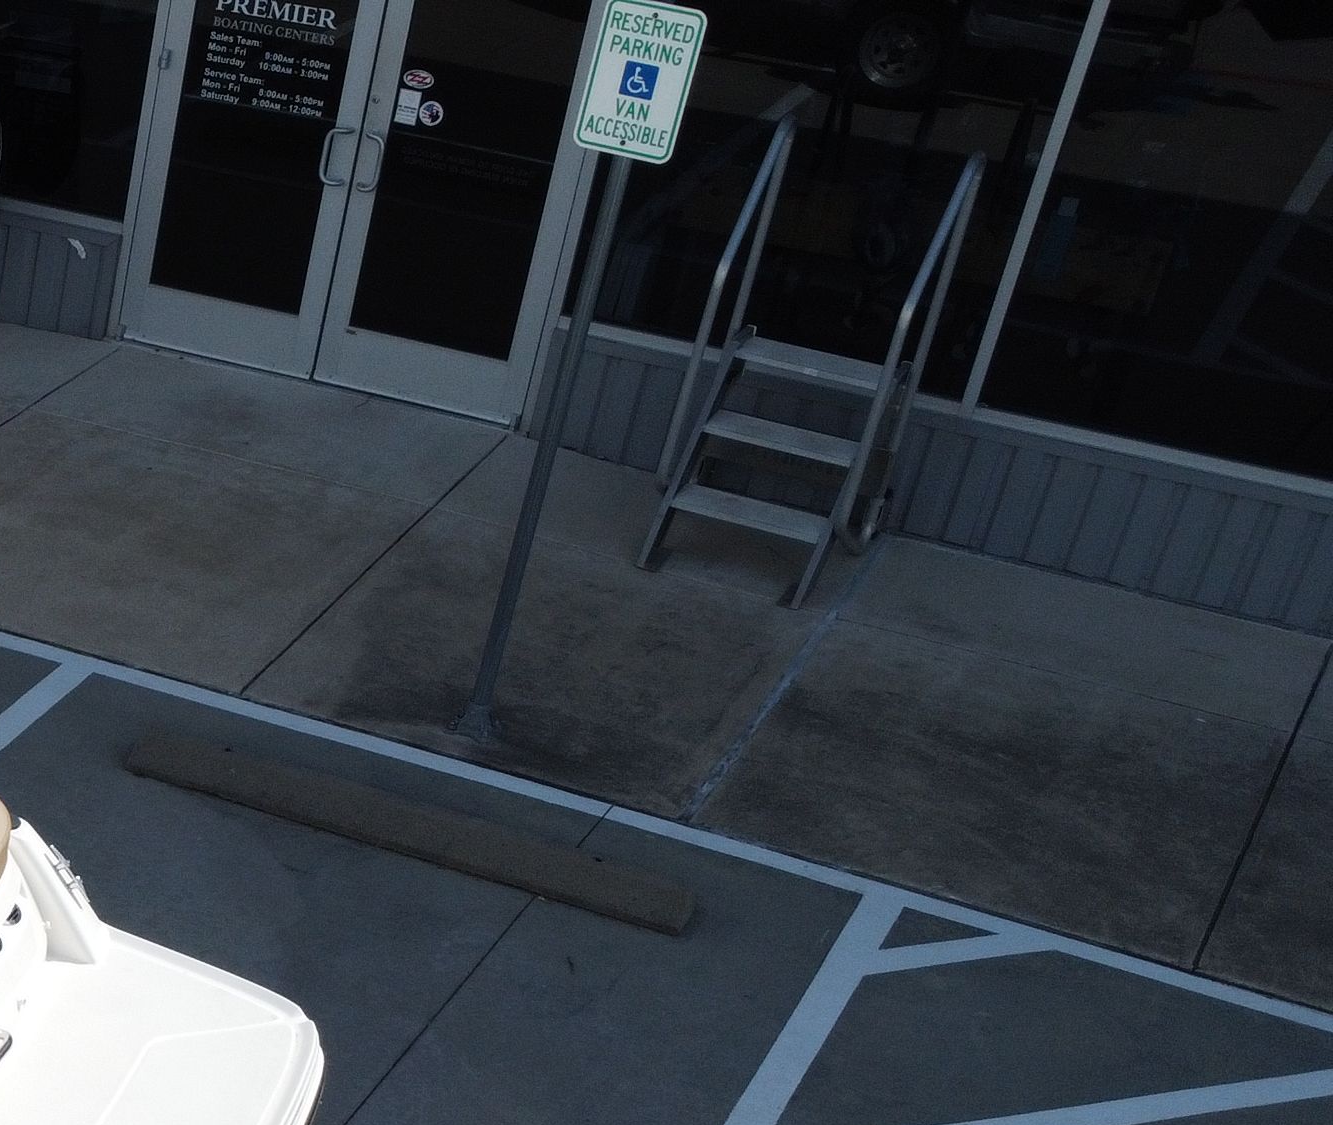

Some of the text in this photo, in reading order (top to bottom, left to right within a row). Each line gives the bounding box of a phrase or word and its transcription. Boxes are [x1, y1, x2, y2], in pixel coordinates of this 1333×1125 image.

[216, 0, 337, 29] PREMIER
[213, 16, 335, 46] BOATING CENTERS
[610, 11, 695, 43] RESERVED
[207, 42, 227, 53] Mon
[234, 45, 247, 56] Fri
[210, 31, 262, 47] Sales Team:
[206, 53, 245, 68] Saturday
[610, 35, 684, 66] PARKING
[202, 78, 221, 89] Mon
[228, 82, 241, 93] Fri
[204, 68, 265, 86] Service Team:
[200, 89, 240, 105] Saturday
[616, 98, 650, 122] VAN
[584, 115, 668, 148] ACCESSIBLE
